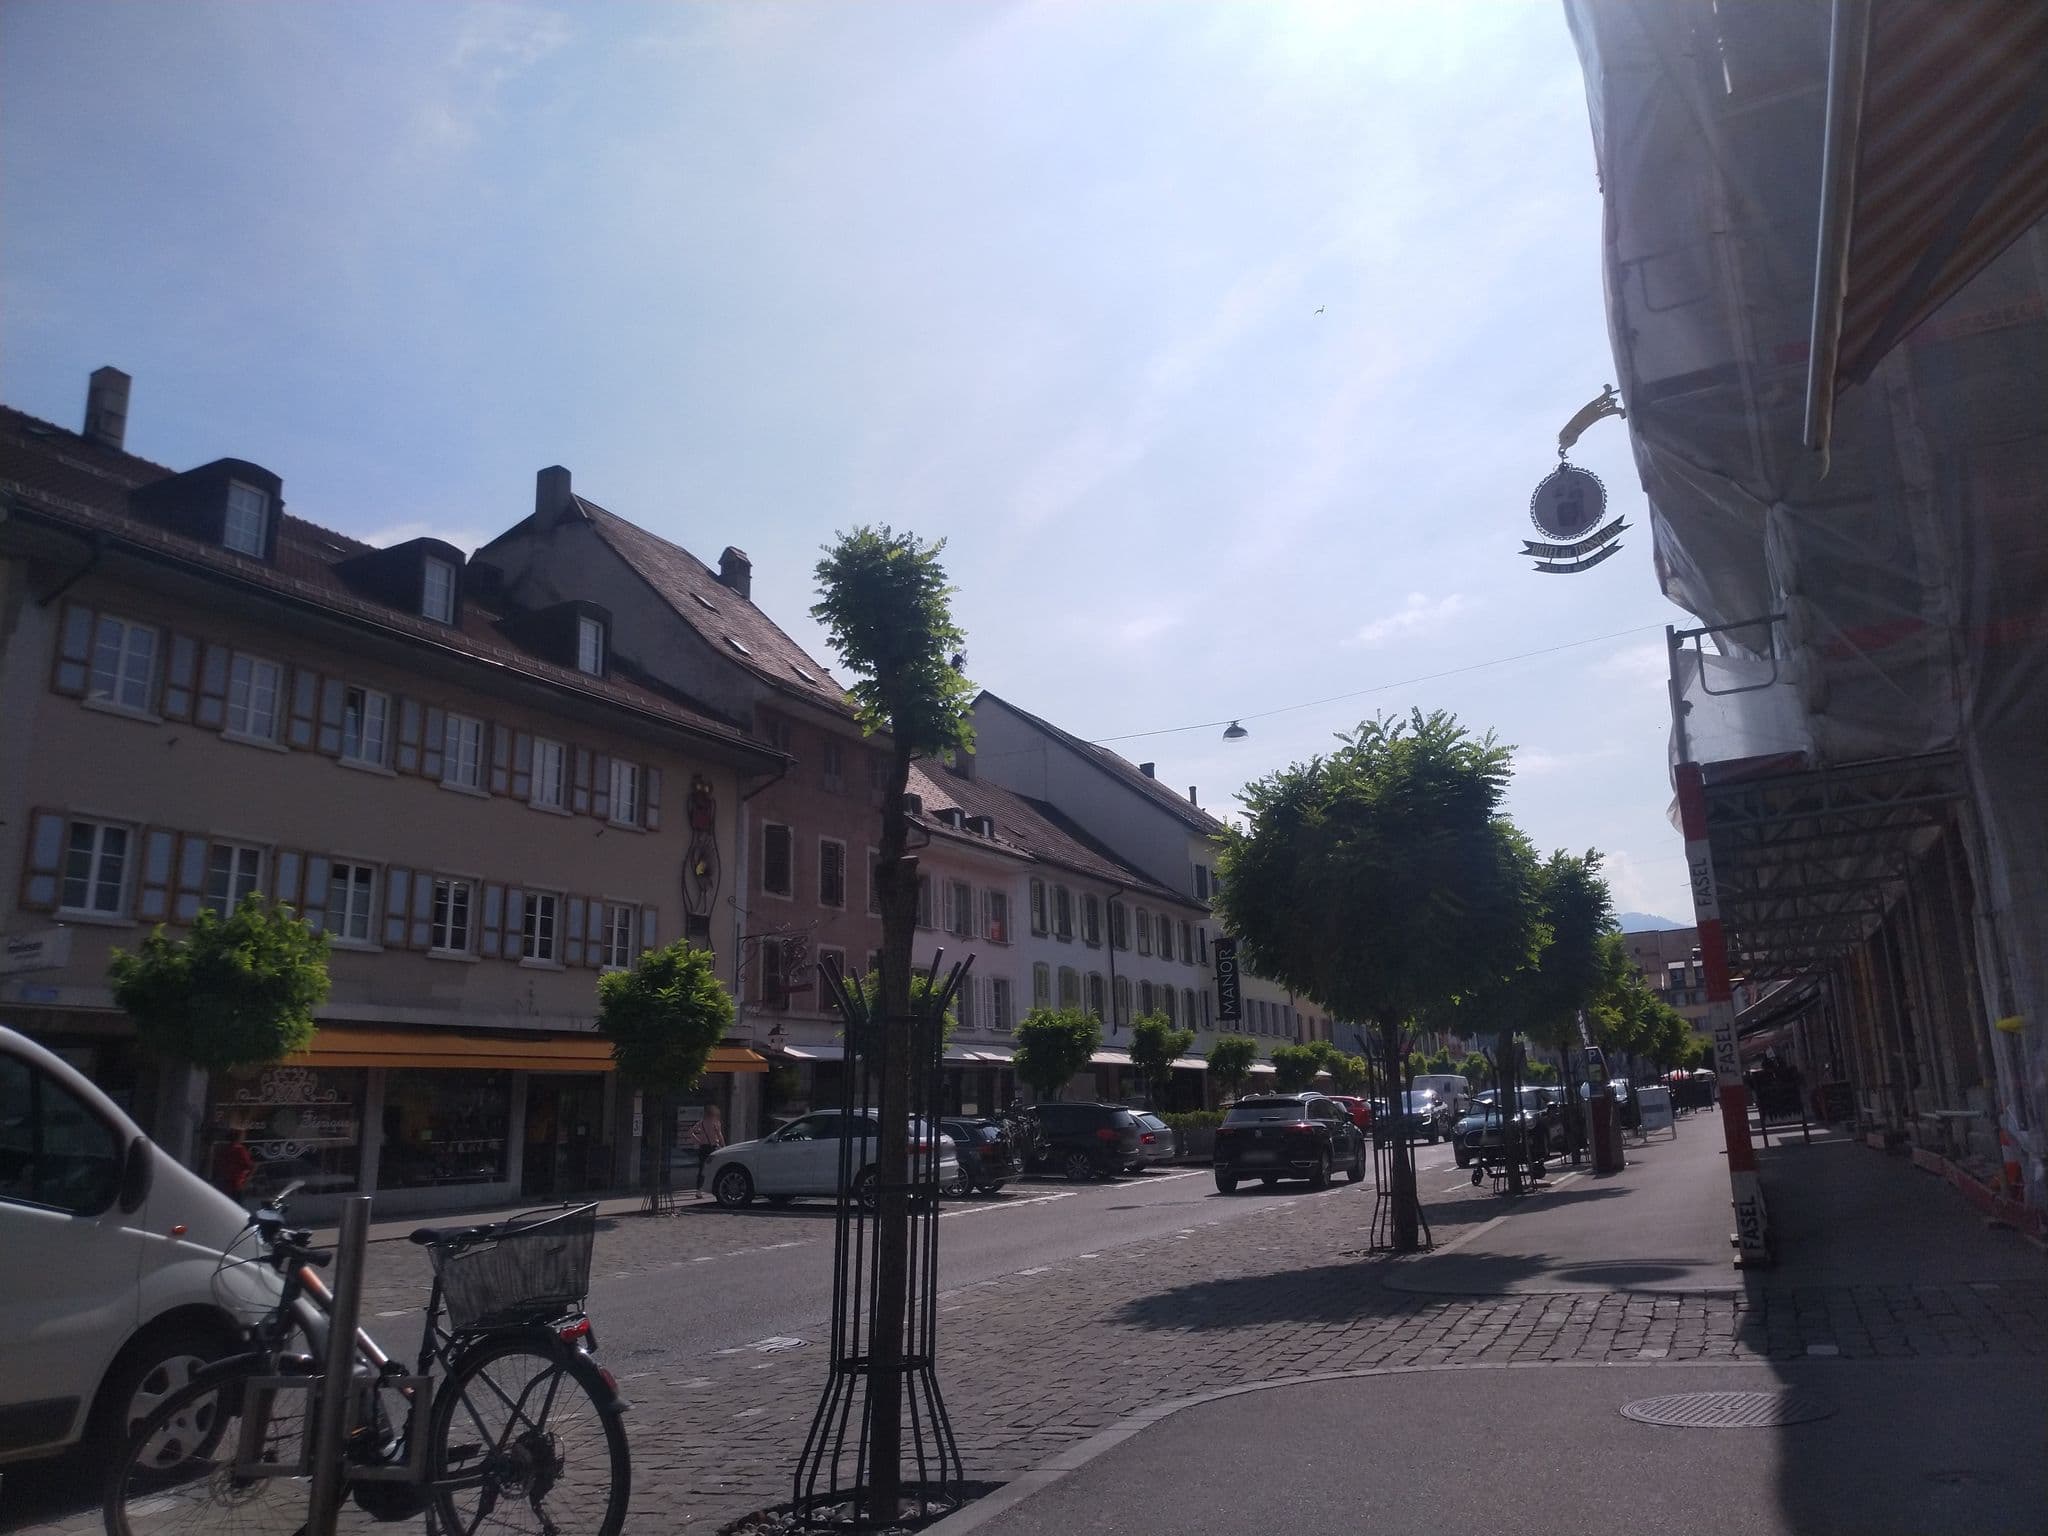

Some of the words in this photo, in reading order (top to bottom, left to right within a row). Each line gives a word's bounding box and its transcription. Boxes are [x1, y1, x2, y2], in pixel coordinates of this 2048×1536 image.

[1532, 544, 1560, 558] HOTEL
[1691, 857, 1712, 907] FASEL
[1219, 948, 1236, 1014] MANOR
[1715, 1022, 1736, 1073] FASEL
[1740, 1195, 1761, 1250] FASEL
